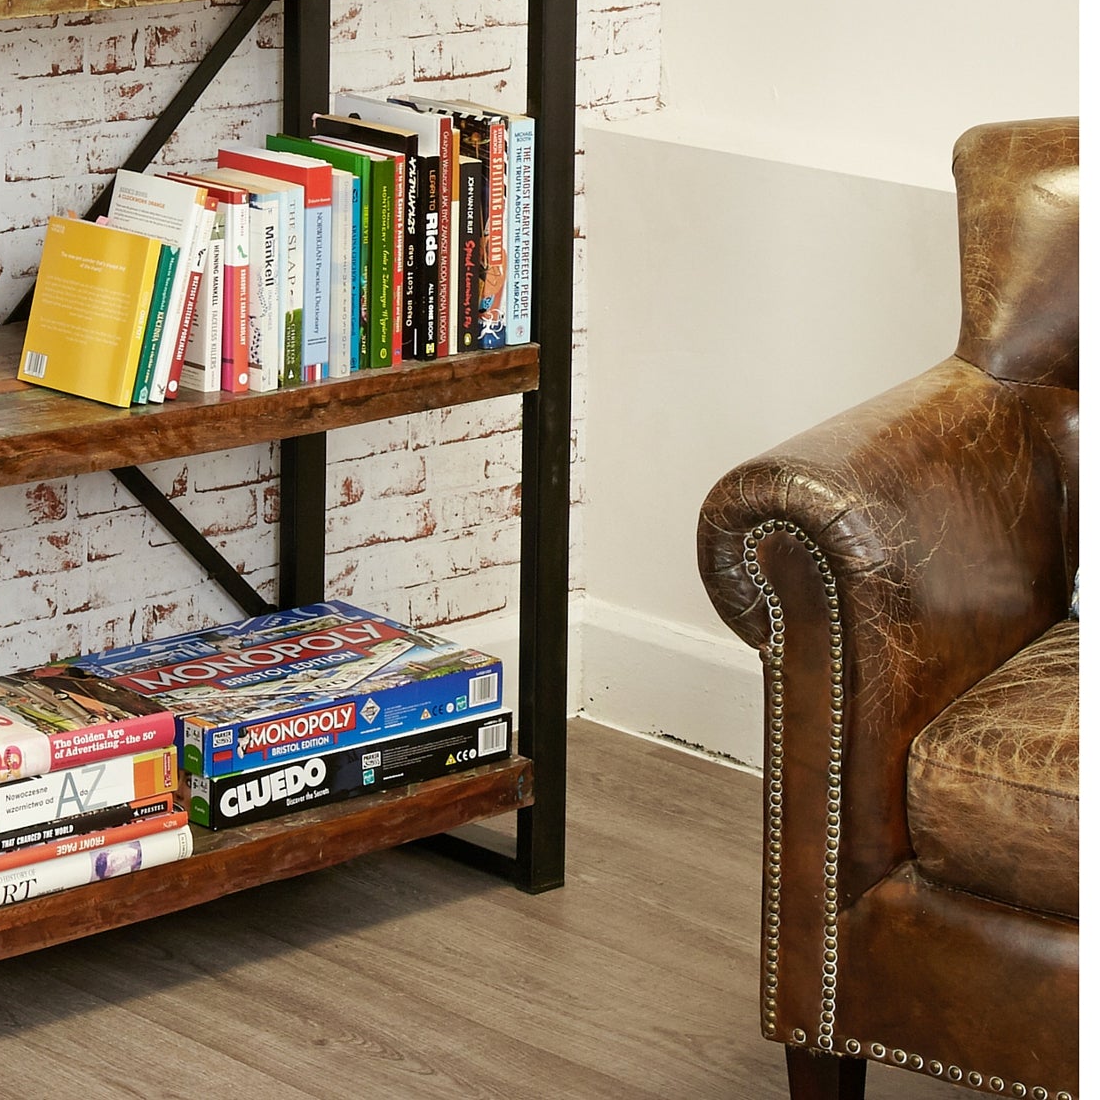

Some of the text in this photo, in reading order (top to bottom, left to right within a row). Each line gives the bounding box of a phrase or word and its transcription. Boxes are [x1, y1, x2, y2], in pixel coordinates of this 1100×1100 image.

[429, 199, 436, 211] TO
[467, 211, 474, 219] DE
[315, 212, 323, 262] NORWEGIAN
[491, 215, 503, 231] THE
[520, 146, 531, 318] THE ALMOST NEARLY PERFECT PEOPLE
[287, 202, 297, 286] THE SLAP
[425, 212, 438, 266] Ride
[491, 235, 503, 262] ATOM
[212, 244, 220, 275] HENNING
[265, 225, 275, 286] Mankell
[513, 245, 521, 279] NORDIC
[211, 276, 219, 306] MANKELL
[314, 263, 323, 294] Practical
[210, 310, 218, 342] FACELESS
[313, 296, 322, 334] Dictionary
[129, 623, 382, 690] MONOPOLY
[220, 650, 360, 687] BRISTOL EDITION
[53, 729, 125, 750] The Golden Age
[249, 709, 352, 748] MONOPOLY
[54, 749, 65, 759] of
[271, 736, 329, 756] BRISTOL EDITION
[5, 787, 48, 802] Nowoczesne
[6, 764, 108, 819] wzornictwo od A do Z
[220, 757, 327, 817] CLUEDO
[140, 804, 165, 815] PRESTEL
[1, 838, 16, 849] THAT
[16, 832, 42, 847] CHANGED
[42, 830, 54, 840] THE
[54, 825, 74, 838] WORLD
[56, 835, 105, 856] FRONT PAGE
